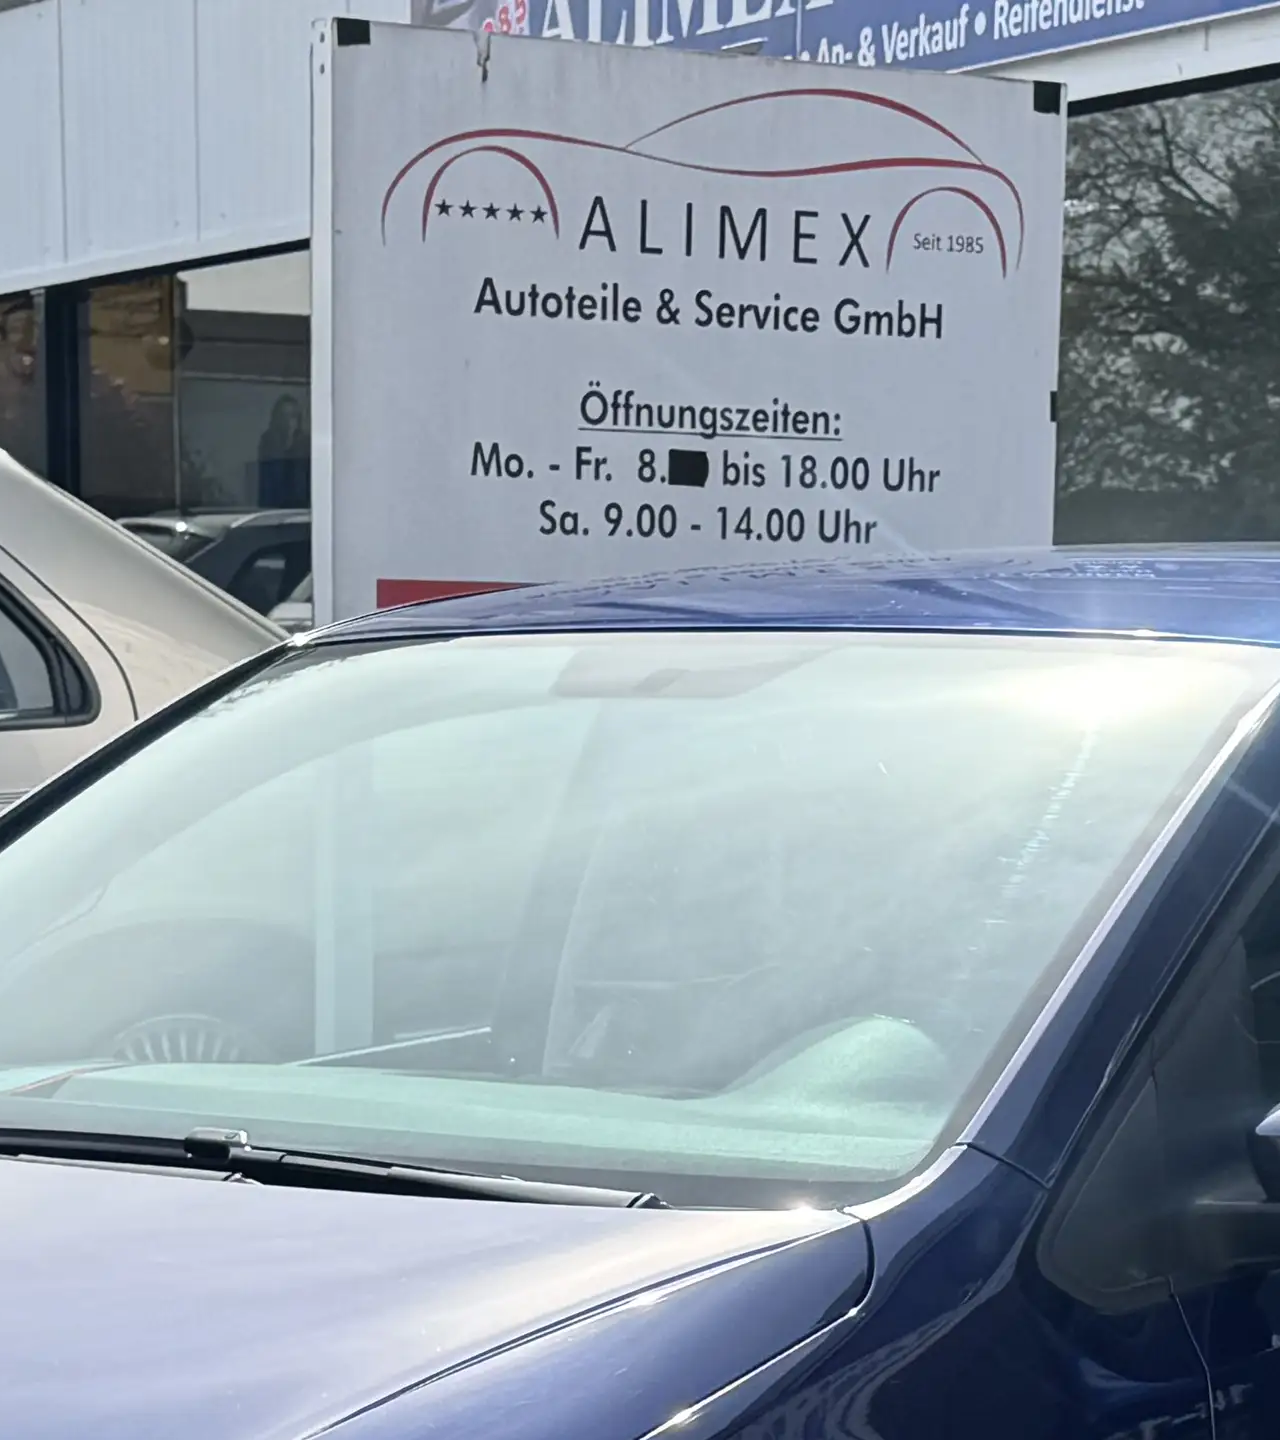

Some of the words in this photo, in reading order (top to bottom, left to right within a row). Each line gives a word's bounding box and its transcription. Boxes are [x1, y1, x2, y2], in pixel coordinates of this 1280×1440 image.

[857, 26, 876, 67] &
[881, 2, 971, 64] Verkauf
[579, 196, 871, 268] ALIMEX
[912, 232, 942, 253] Seit
[947, 234, 985, 255] 1985
[474, 277, 642, 325] Autoteile
[657, 290, 681, 326] &
[694, 290, 820, 333] Service
[834, 299, 944, 340] GmbH
[580, 382, 842, 438] Öffnungszeiten:
[470, 442, 534, 481] Mo.
[575, 446, 612, 482] Fr.
[722, 450, 766, 489] bis
[781, 454, 870, 491] 18.00
[883, 458, 940, 493] Uhr
[539, 502, 589, 537] Sa.
[604, 504, 677, 539] 9.00
[719, 507, 805, 542] 14.00
[818, 511, 877, 546] Uhr
